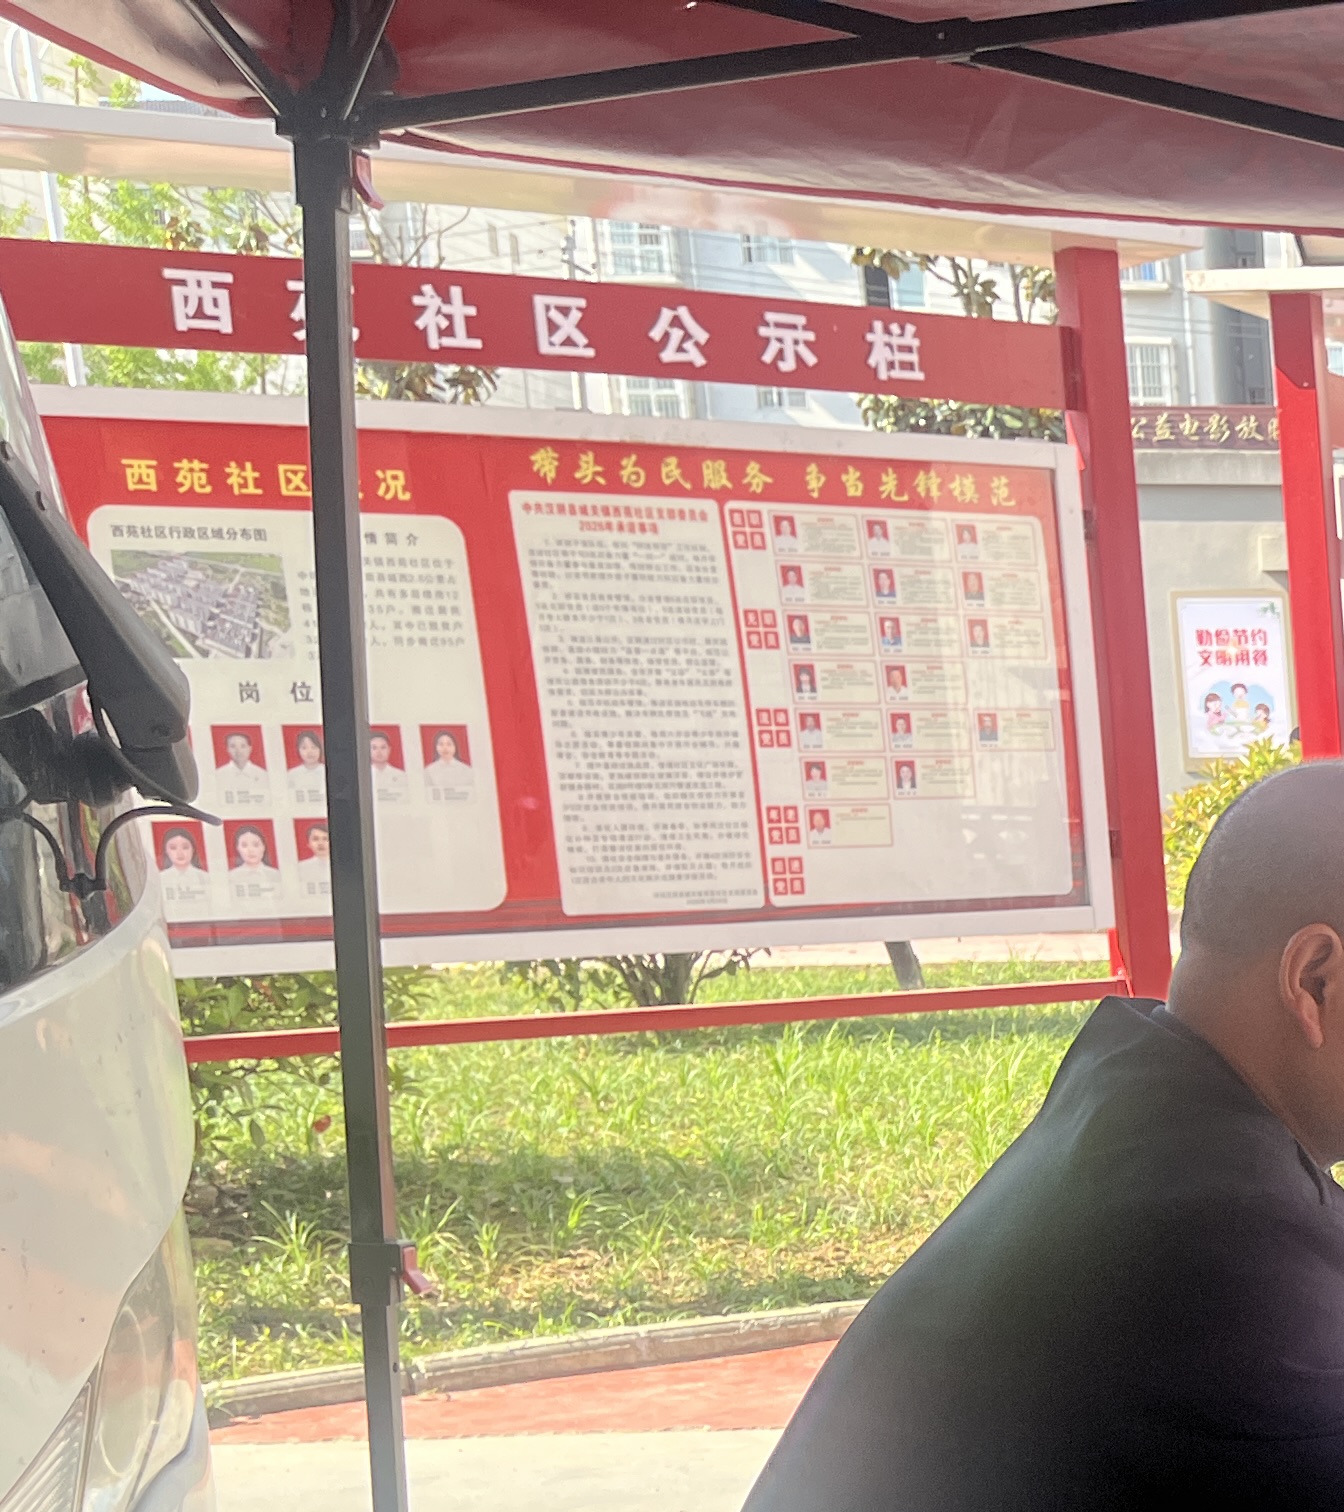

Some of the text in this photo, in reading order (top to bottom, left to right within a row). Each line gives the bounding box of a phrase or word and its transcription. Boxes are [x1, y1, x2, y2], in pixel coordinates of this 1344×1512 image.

[122, 458, 411, 502] 西苑社区况
[529, 446, 1017, 507] 带头为民服务 争当先锋模范
[110, 524, 268, 543] 西苑社区行政区域分布图
[238, 681, 315, 704] 岗位
